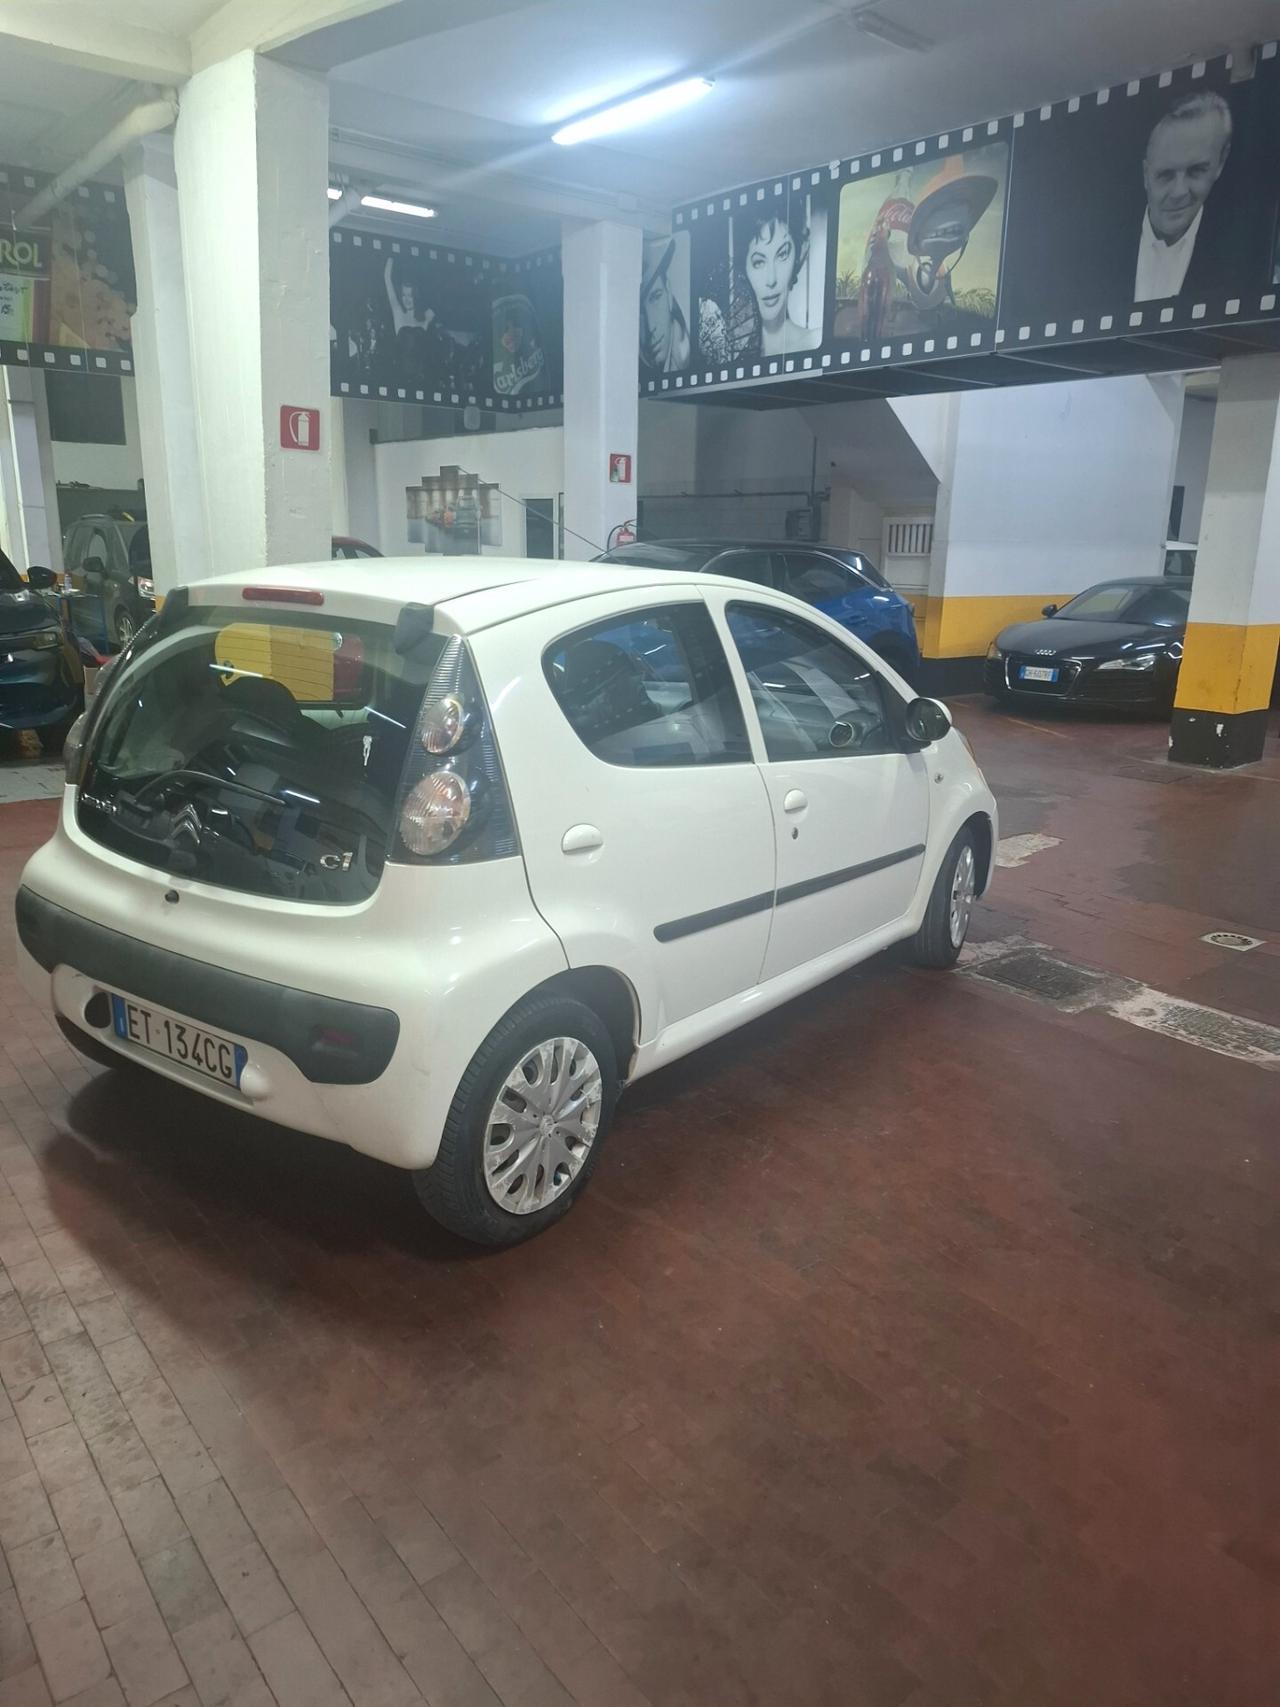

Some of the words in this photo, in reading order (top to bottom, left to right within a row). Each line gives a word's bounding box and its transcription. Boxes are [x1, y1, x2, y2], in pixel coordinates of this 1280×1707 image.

[493, 347, 545, 394] Carlsberg
[319, 851, 354, 871] C1
[127, 1004, 152, 1045] ET
[163, 1019, 233, 1080] 134CG
